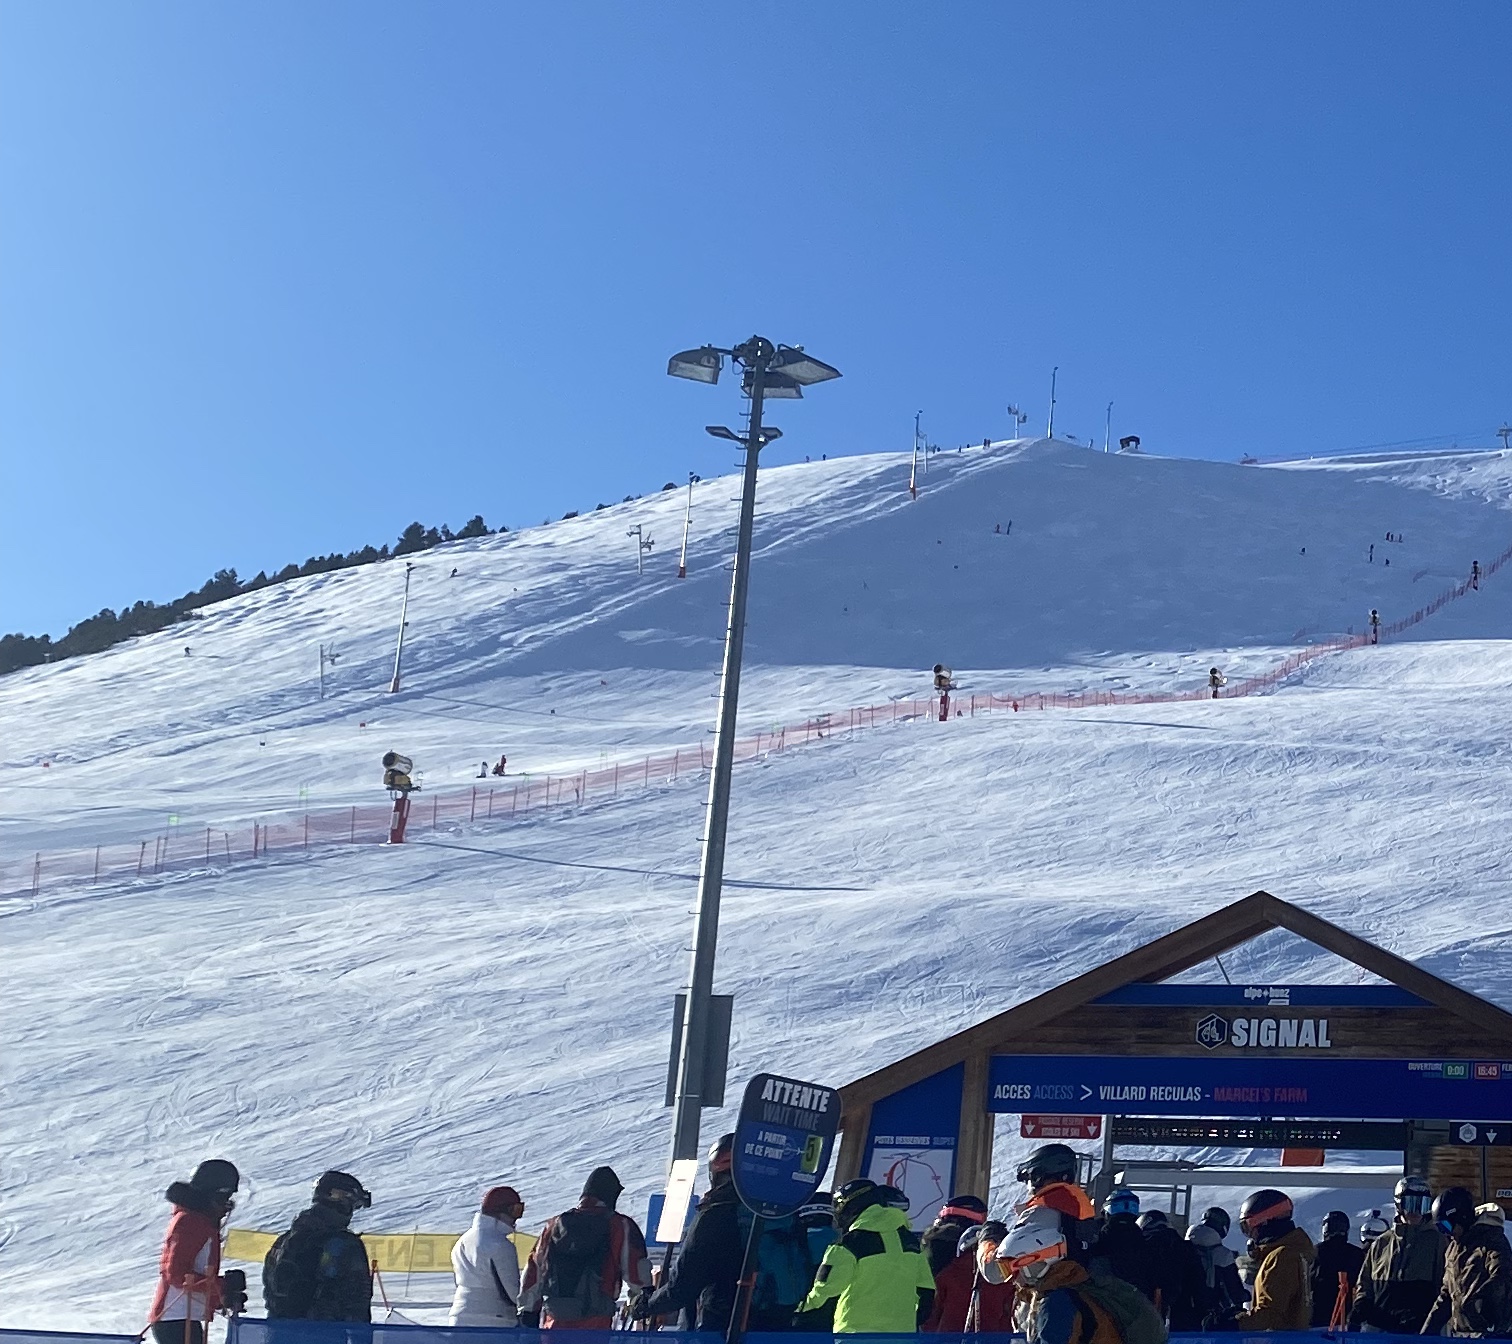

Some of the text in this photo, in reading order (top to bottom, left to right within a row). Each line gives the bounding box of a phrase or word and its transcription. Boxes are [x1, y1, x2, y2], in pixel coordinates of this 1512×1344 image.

[1231, 1018, 1331, 1048] SIGNAL
[761, 1079, 830, 1113] ATTENTE
[994, 1085, 1031, 1099] ACCES
[1033, 1085, 1074, 1100] ACCESS
[1100, 1086, 1146, 1101] VILLARD
[1150, 1087, 1201, 1102] RECULAS
[763, 1102, 820, 1132] WAIT TIME
[805, 1137, 816, 1162] 5
